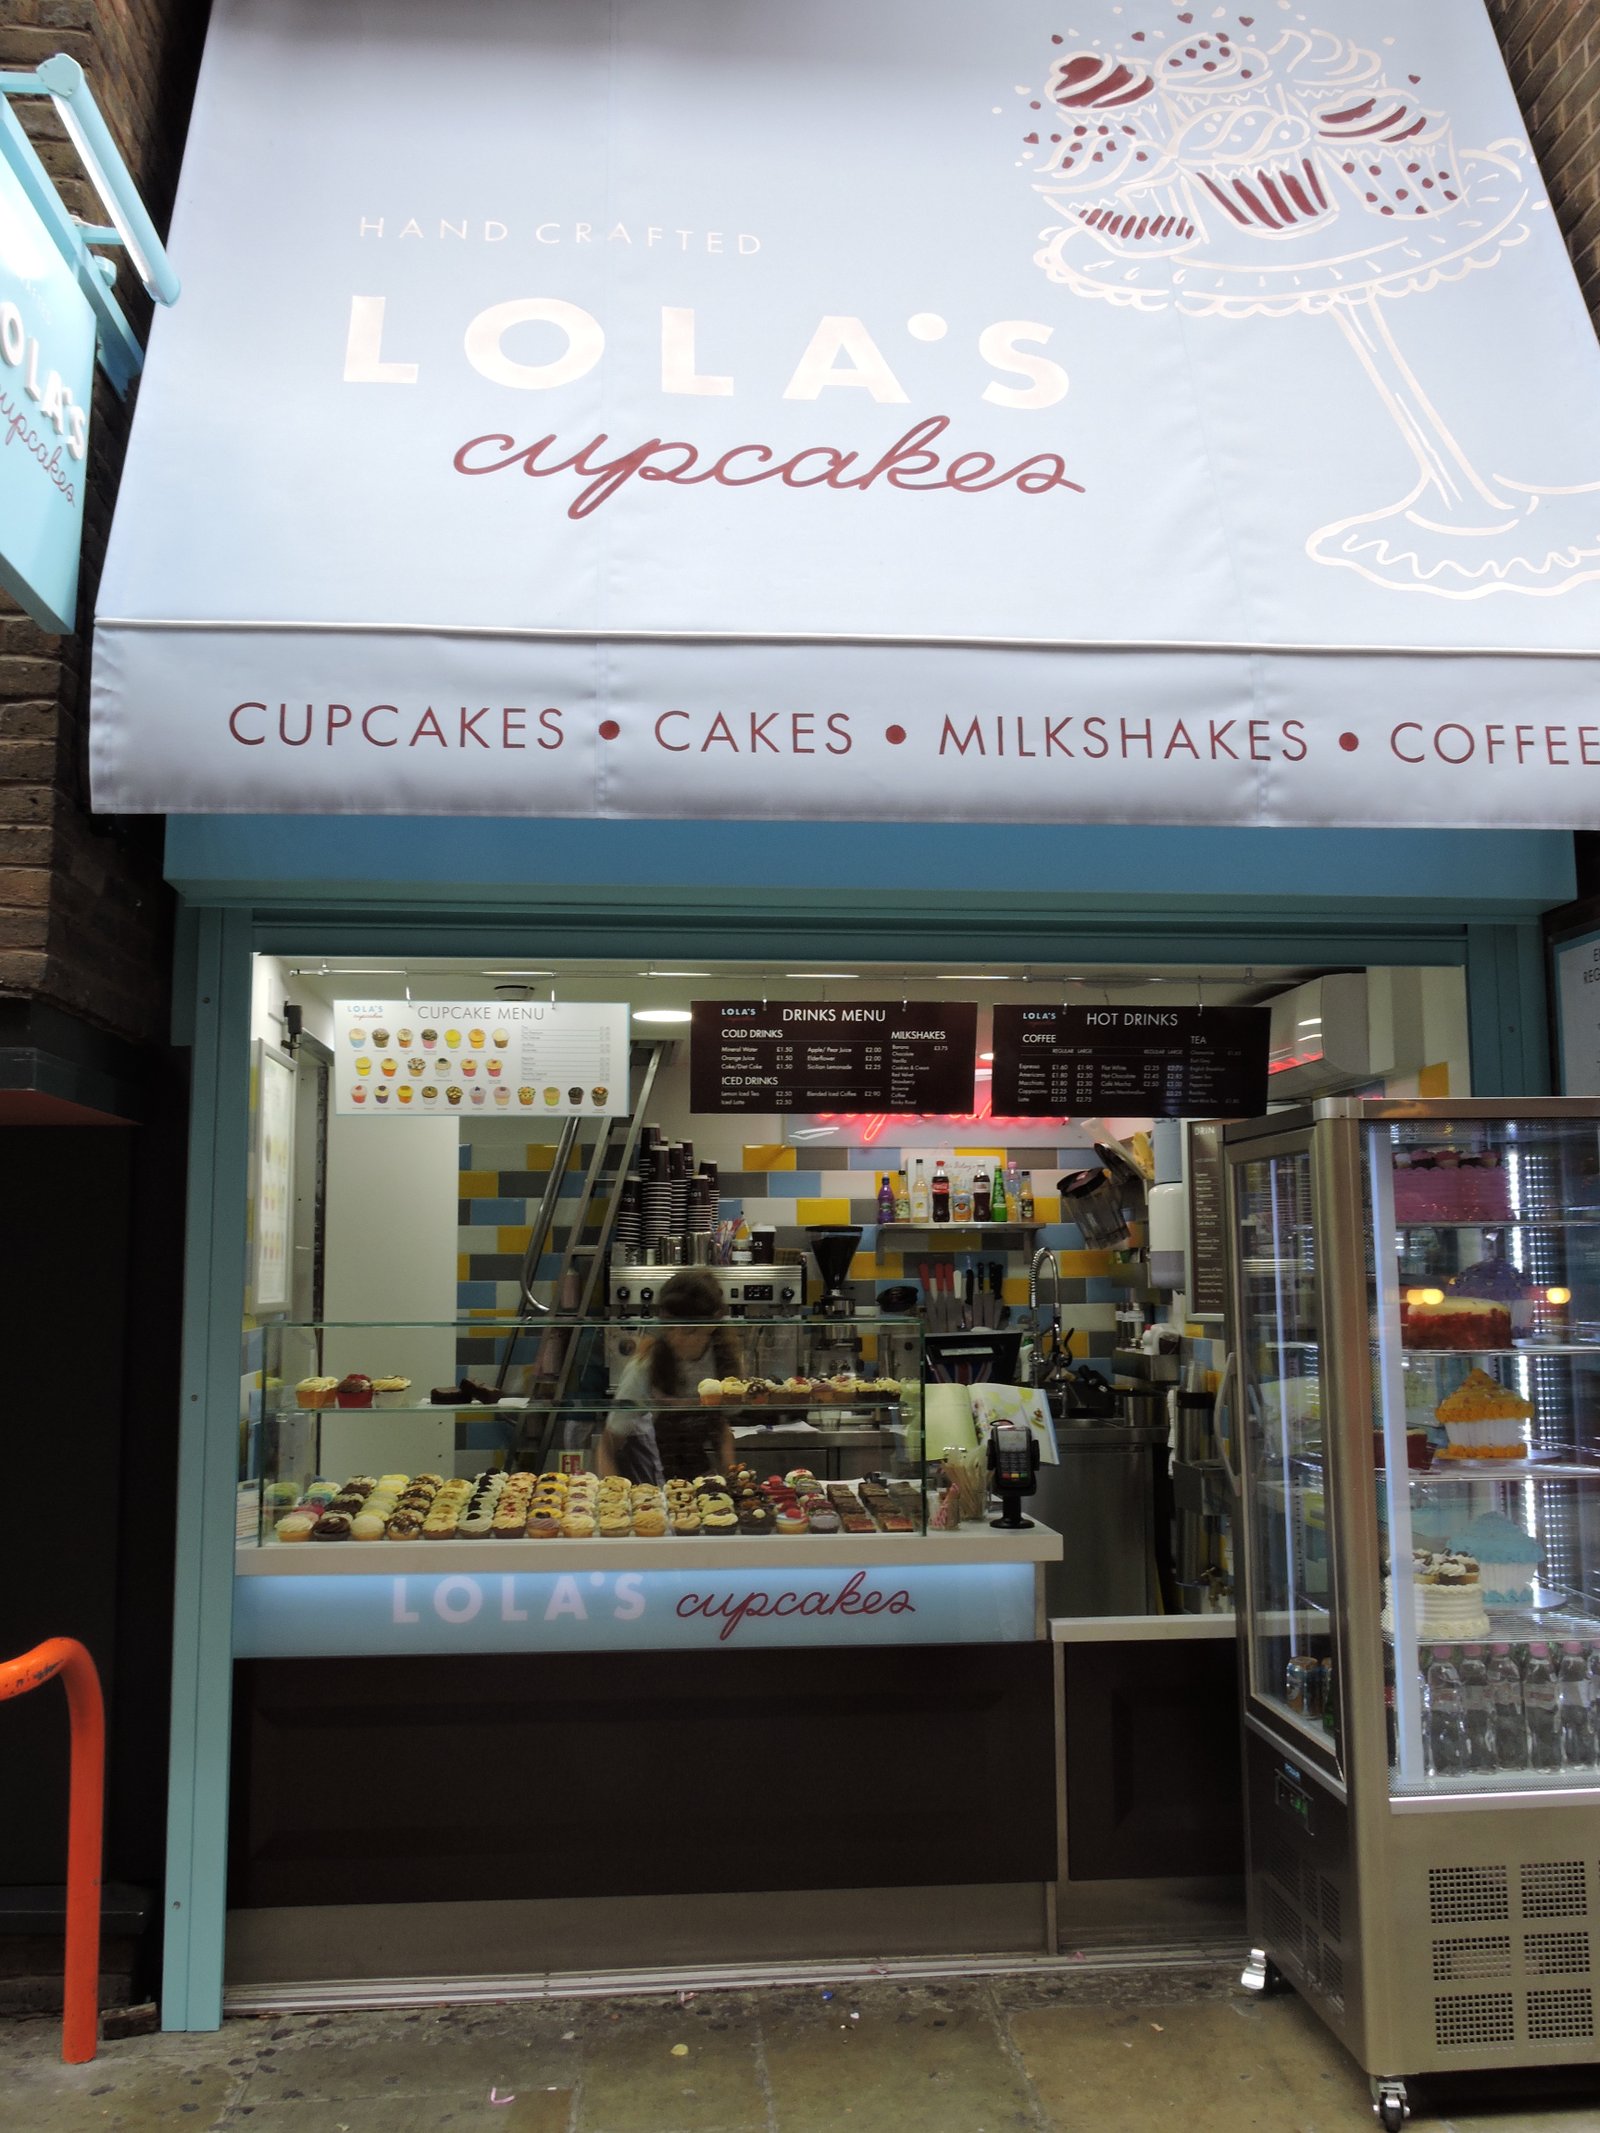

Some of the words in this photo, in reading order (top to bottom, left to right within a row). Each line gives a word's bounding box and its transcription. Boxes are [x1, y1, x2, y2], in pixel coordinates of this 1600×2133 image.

[359, 216, 509, 242] HAND
[535, 222, 762, 256] CRAFTED
[343, 295, 1071, 411] LOLA'S
[0, 301, 86, 461] OLA'S
[453, 415, 1087, 520] cupcakes
[228, 701, 565, 750] CUPCAKES
[654, 710, 854, 754] CAKES
[938, 713, 1309, 763] MILKSHAKES
[1389, 721, 1600, 766] COFFEE
[347, 1005, 384, 1013] LOLA'S
[417, 1006, 492, 1020] CUPCAKE
[497, 1007, 545, 1021] MENU
[721, 1008, 757, 1016] LOLA'S
[782, 1008, 837, 1022] DRINKS
[841, 1009, 886, 1022] MENU
[1022, 1012, 1057, 1020] LOLA'S
[1086, 1013, 1121, 1026] HOT
[1124, 1013, 1178, 1027] DRINKS
[721, 1029, 748, 1038] COLD
[749, 1029, 783, 1038] DRINKS
[891, 1031, 946, 1040] MILKSHAKES
[1022, 1034, 1057, 1043] COFFEE
[1190, 1035, 1207, 1045] TEA
[721, 1076, 743, 1085] ICED
[745, 1076, 779, 1085] DRINKS
[1194, 1126, 1215, 1136] DRIN
[391, 1571, 647, 1624] LOLA'S
[677, 1570, 917, 1641] cupcakes
